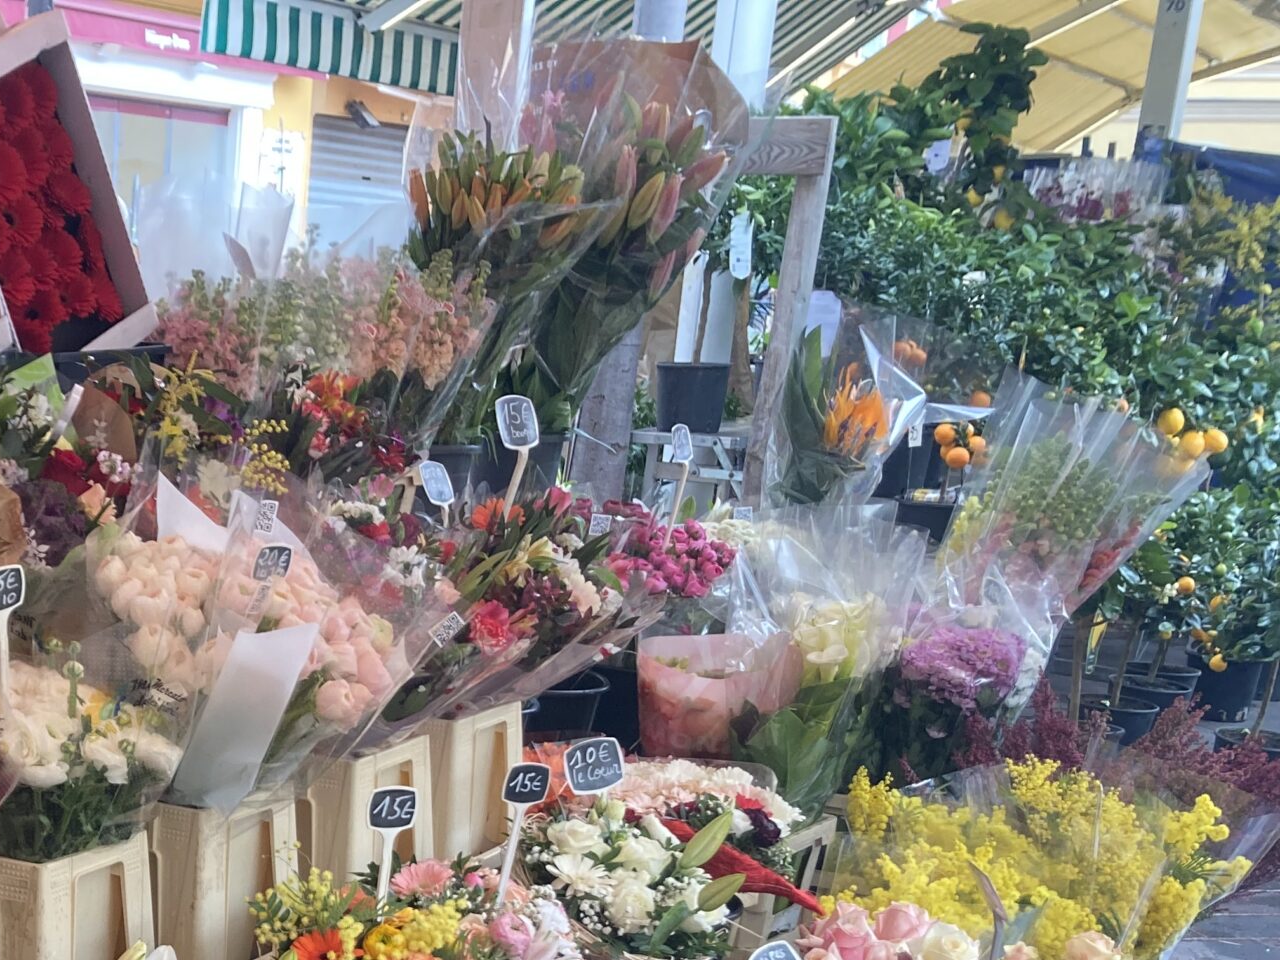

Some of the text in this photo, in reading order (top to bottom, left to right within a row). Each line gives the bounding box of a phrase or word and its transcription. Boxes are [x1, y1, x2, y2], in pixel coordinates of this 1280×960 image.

[2, 592, 17, 605] 10
[509, 772, 542, 793] 15€
[373, 794, 415, 820] 15€
